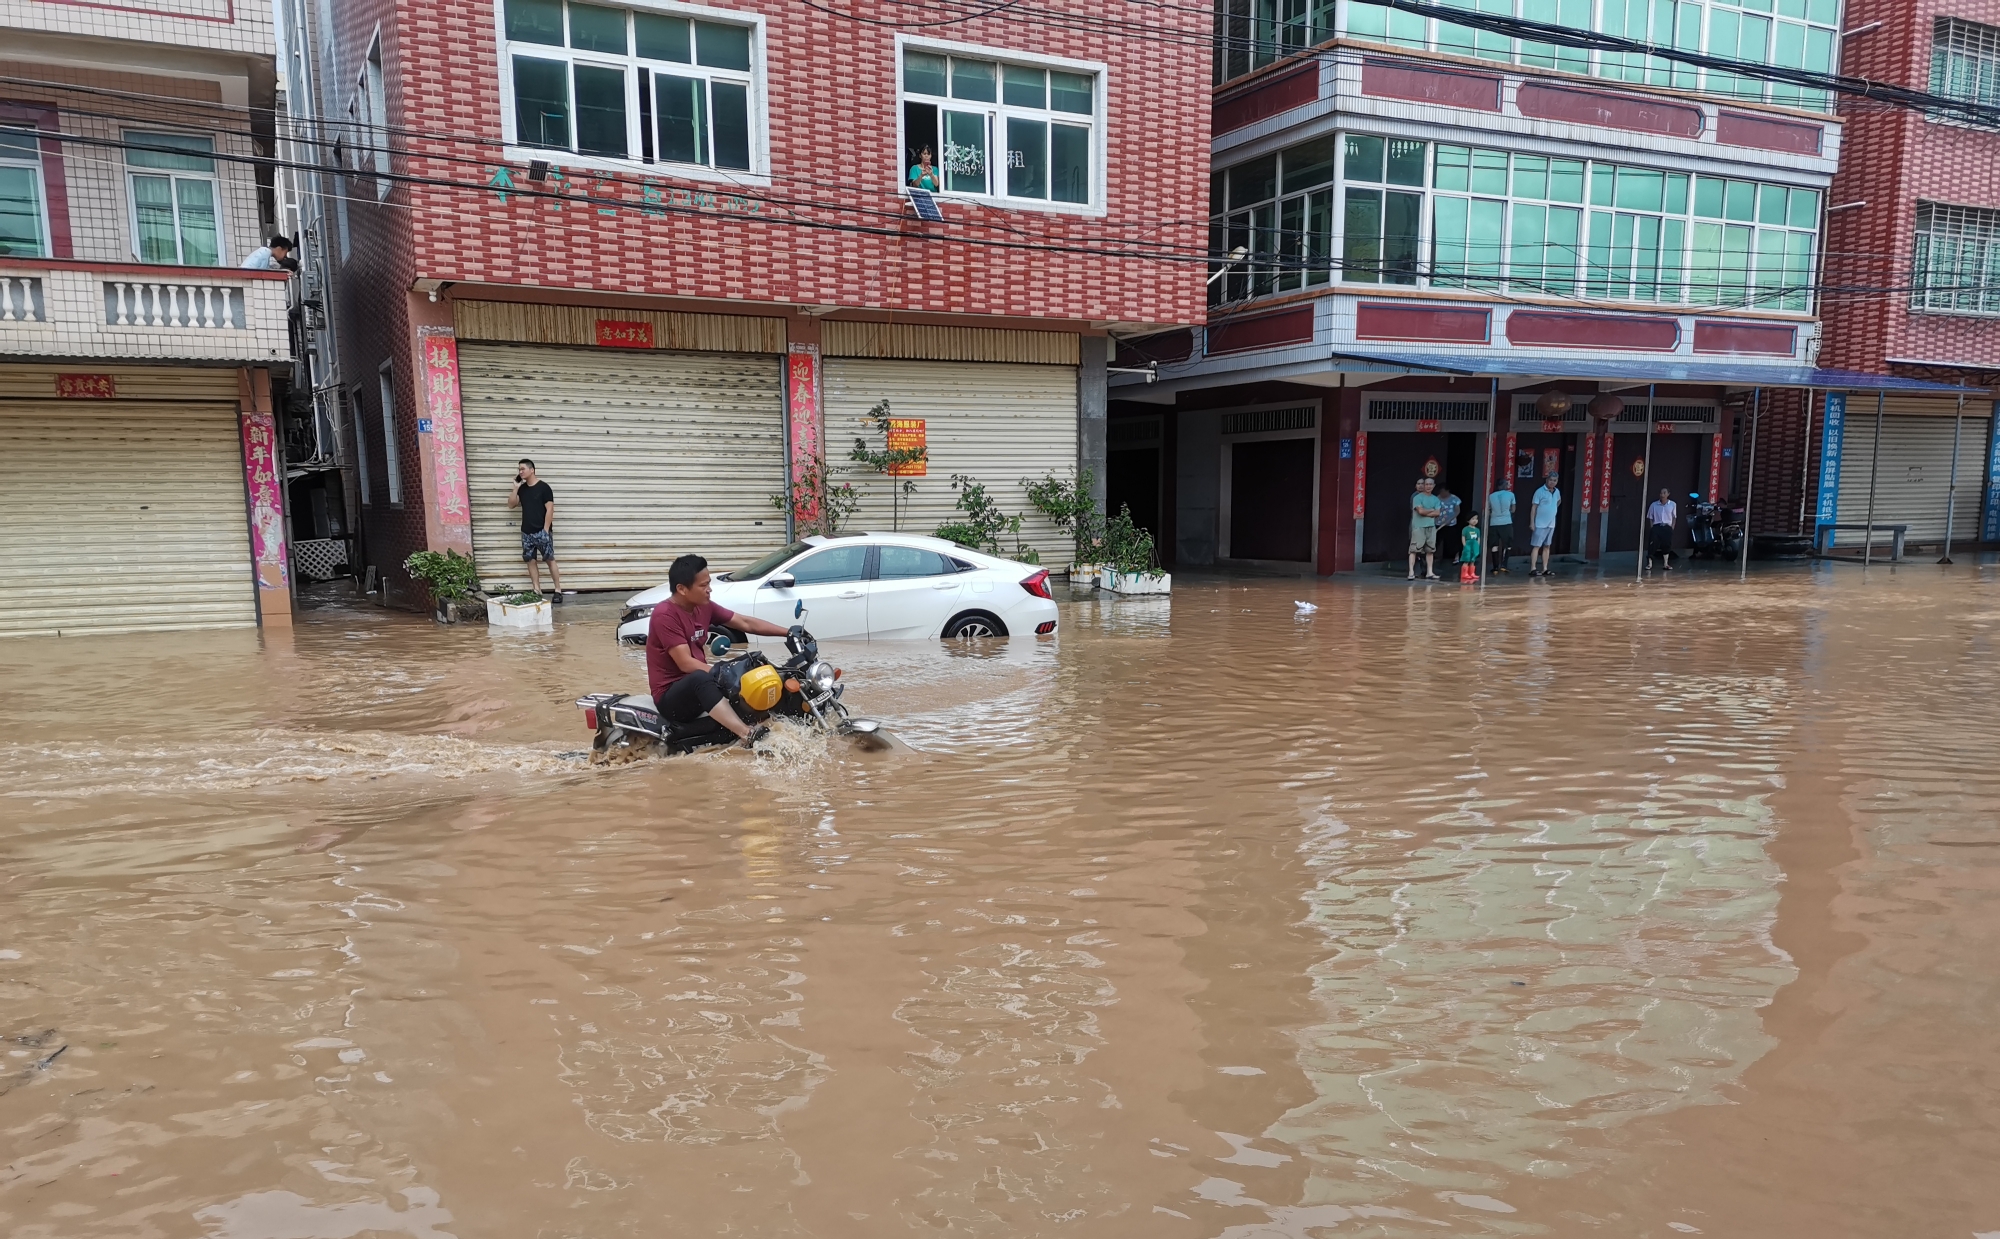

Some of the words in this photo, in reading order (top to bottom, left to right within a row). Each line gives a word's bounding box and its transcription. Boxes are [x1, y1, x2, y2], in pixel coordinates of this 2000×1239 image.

[1828, 398, 1841, 426] 手机回收
[429, 345, 467, 517] 接財接福接平安
[1826, 429, 1839, 457] 以旧换新
[1823, 460, 1836, 488] 换屏贴膜
